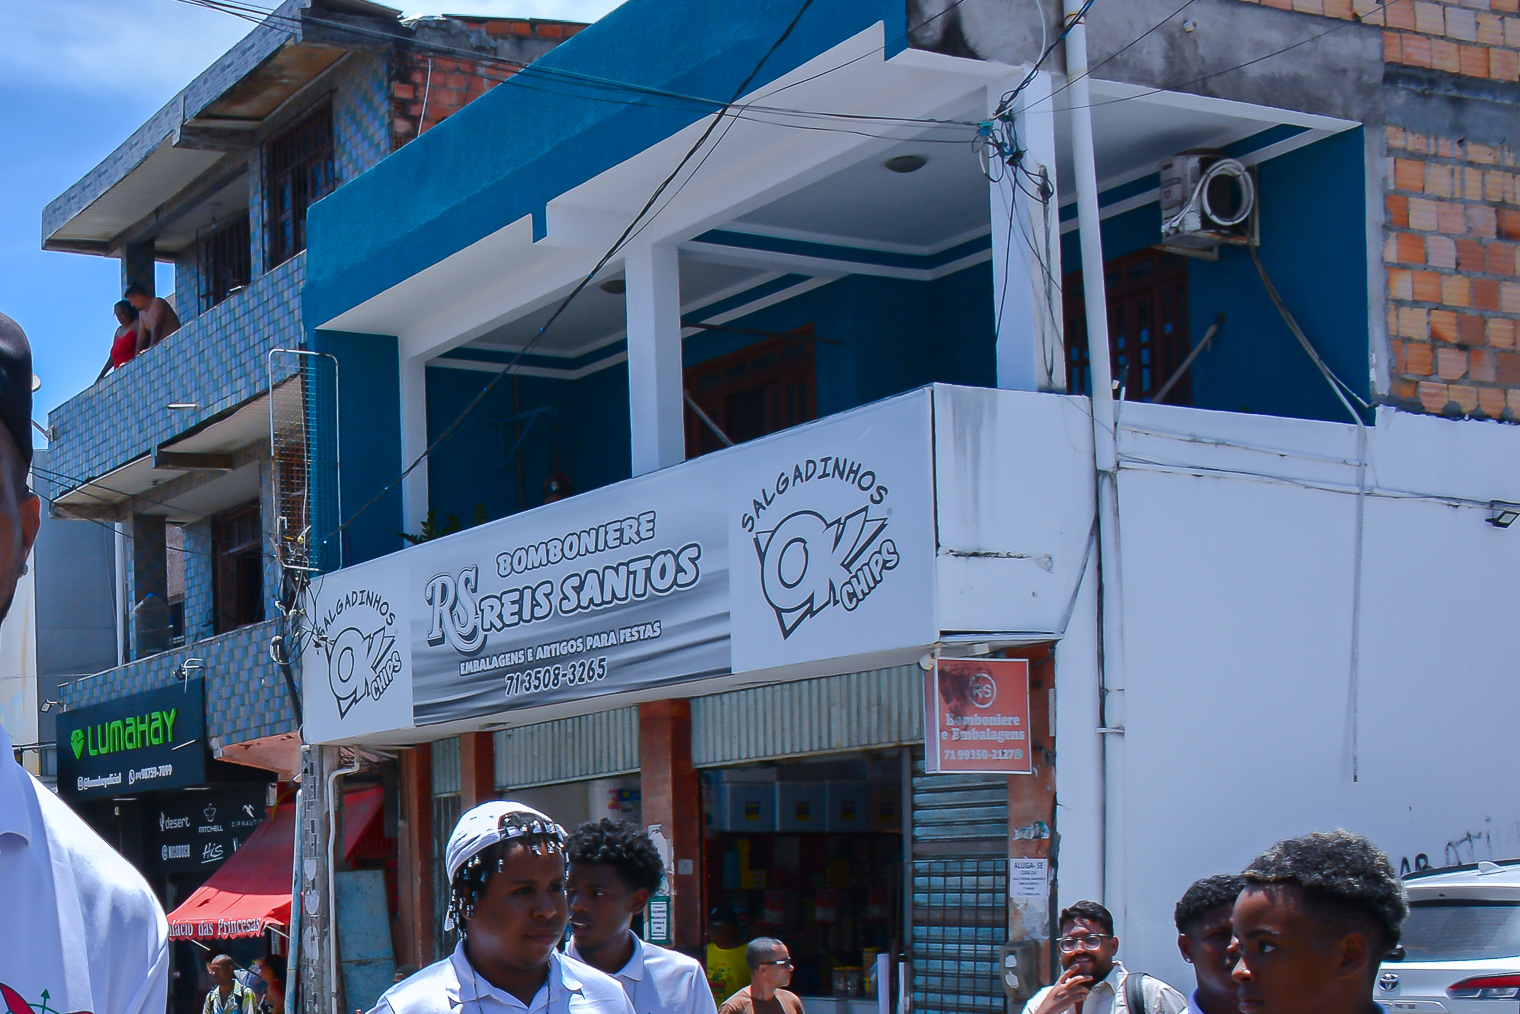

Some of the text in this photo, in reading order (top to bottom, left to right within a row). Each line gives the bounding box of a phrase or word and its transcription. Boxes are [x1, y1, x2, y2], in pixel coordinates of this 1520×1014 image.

[742, 456, 888, 532] SALGADINHOS
[497, 511, 656, 577] BOMBONIERE
[479, 543, 702, 633] REIS SANTOS
[840, 538, 900, 612] CHIPS
[318, 590, 395, 637] SALGADINHOS
[425, 565, 488, 657] RS
[459, 620, 662, 676] EMBALAGENS E ARTIGOS PARA FESTAS
[370, 651, 402, 701] CHIPS
[505, 658, 607, 695] 71 3508-3265
[973, 684, 992, 698] RS
[941, 728, 1025, 743] e Embalagens
[946, 713, 1020, 726] Bomboniere
[165, 816, 190, 829] desert
[198, 919, 214, 936] das
[217, 917, 262, 935] Princesas
